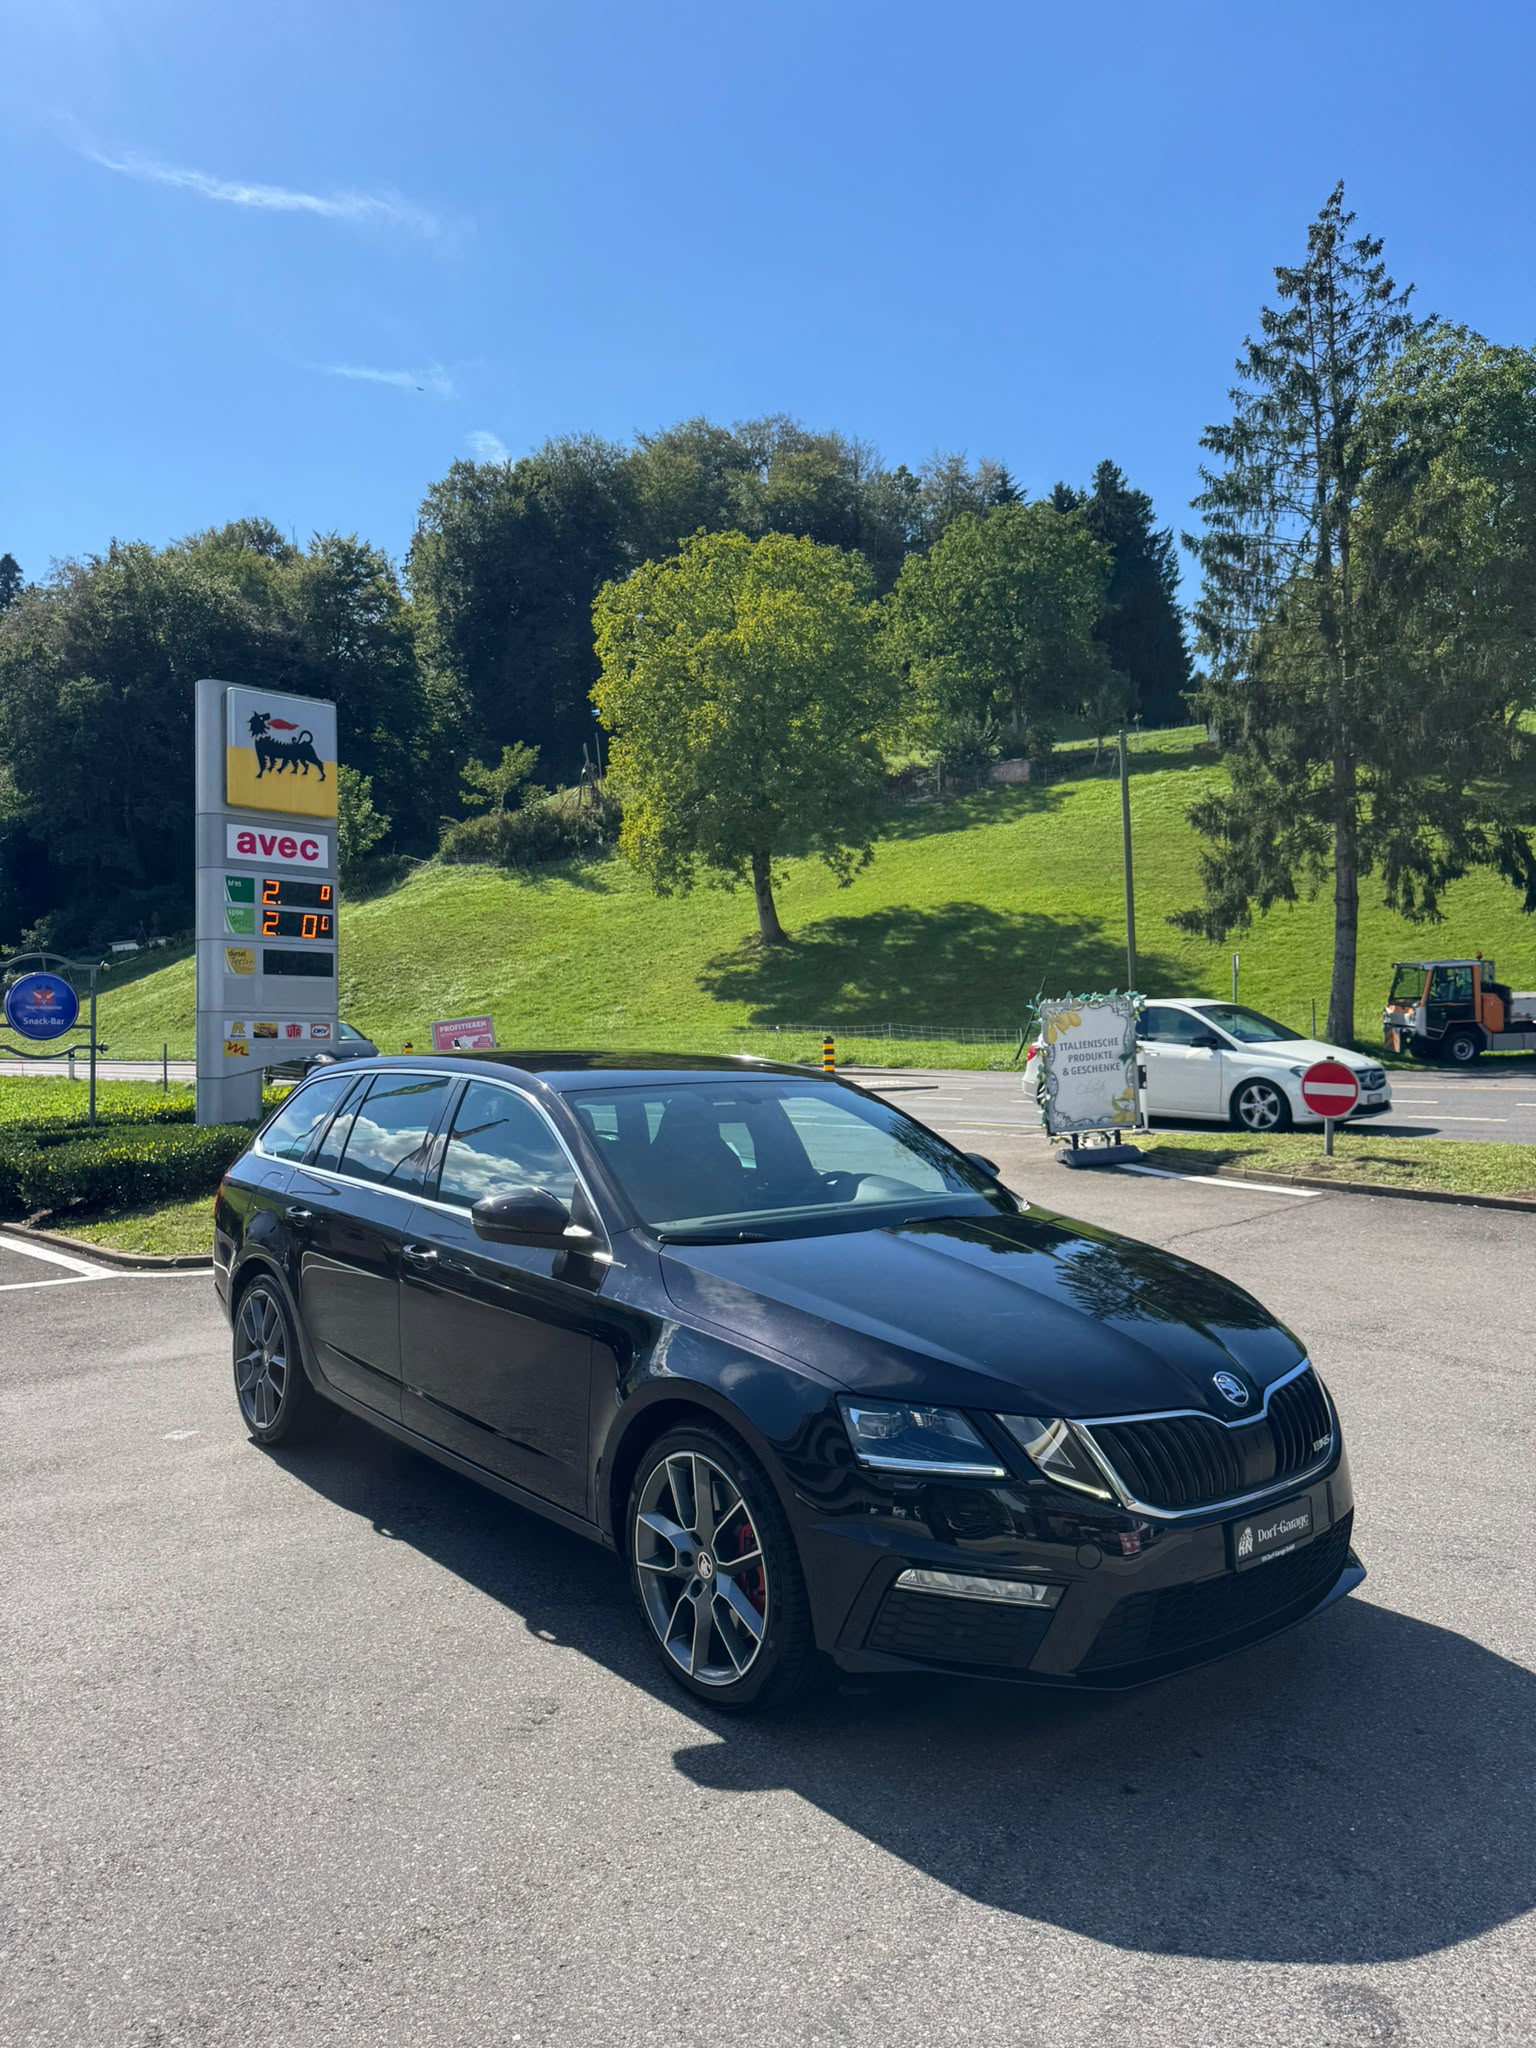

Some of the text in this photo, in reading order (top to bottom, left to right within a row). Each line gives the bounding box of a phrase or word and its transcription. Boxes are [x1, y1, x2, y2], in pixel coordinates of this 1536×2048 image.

[236, 832, 319, 861] avec
[23, 1016, 65, 1025] Snack-Bar
[287, 1025, 302, 1038] UTA
[1060, 1037, 1119, 1051] ITALIENISCHE
[1068, 1051, 1113, 1063] PRODUKTE
[1062, 1063, 1121, 1076] & GESCHENKE
[1257, 1514, 1309, 1542] Dorf-Garage
